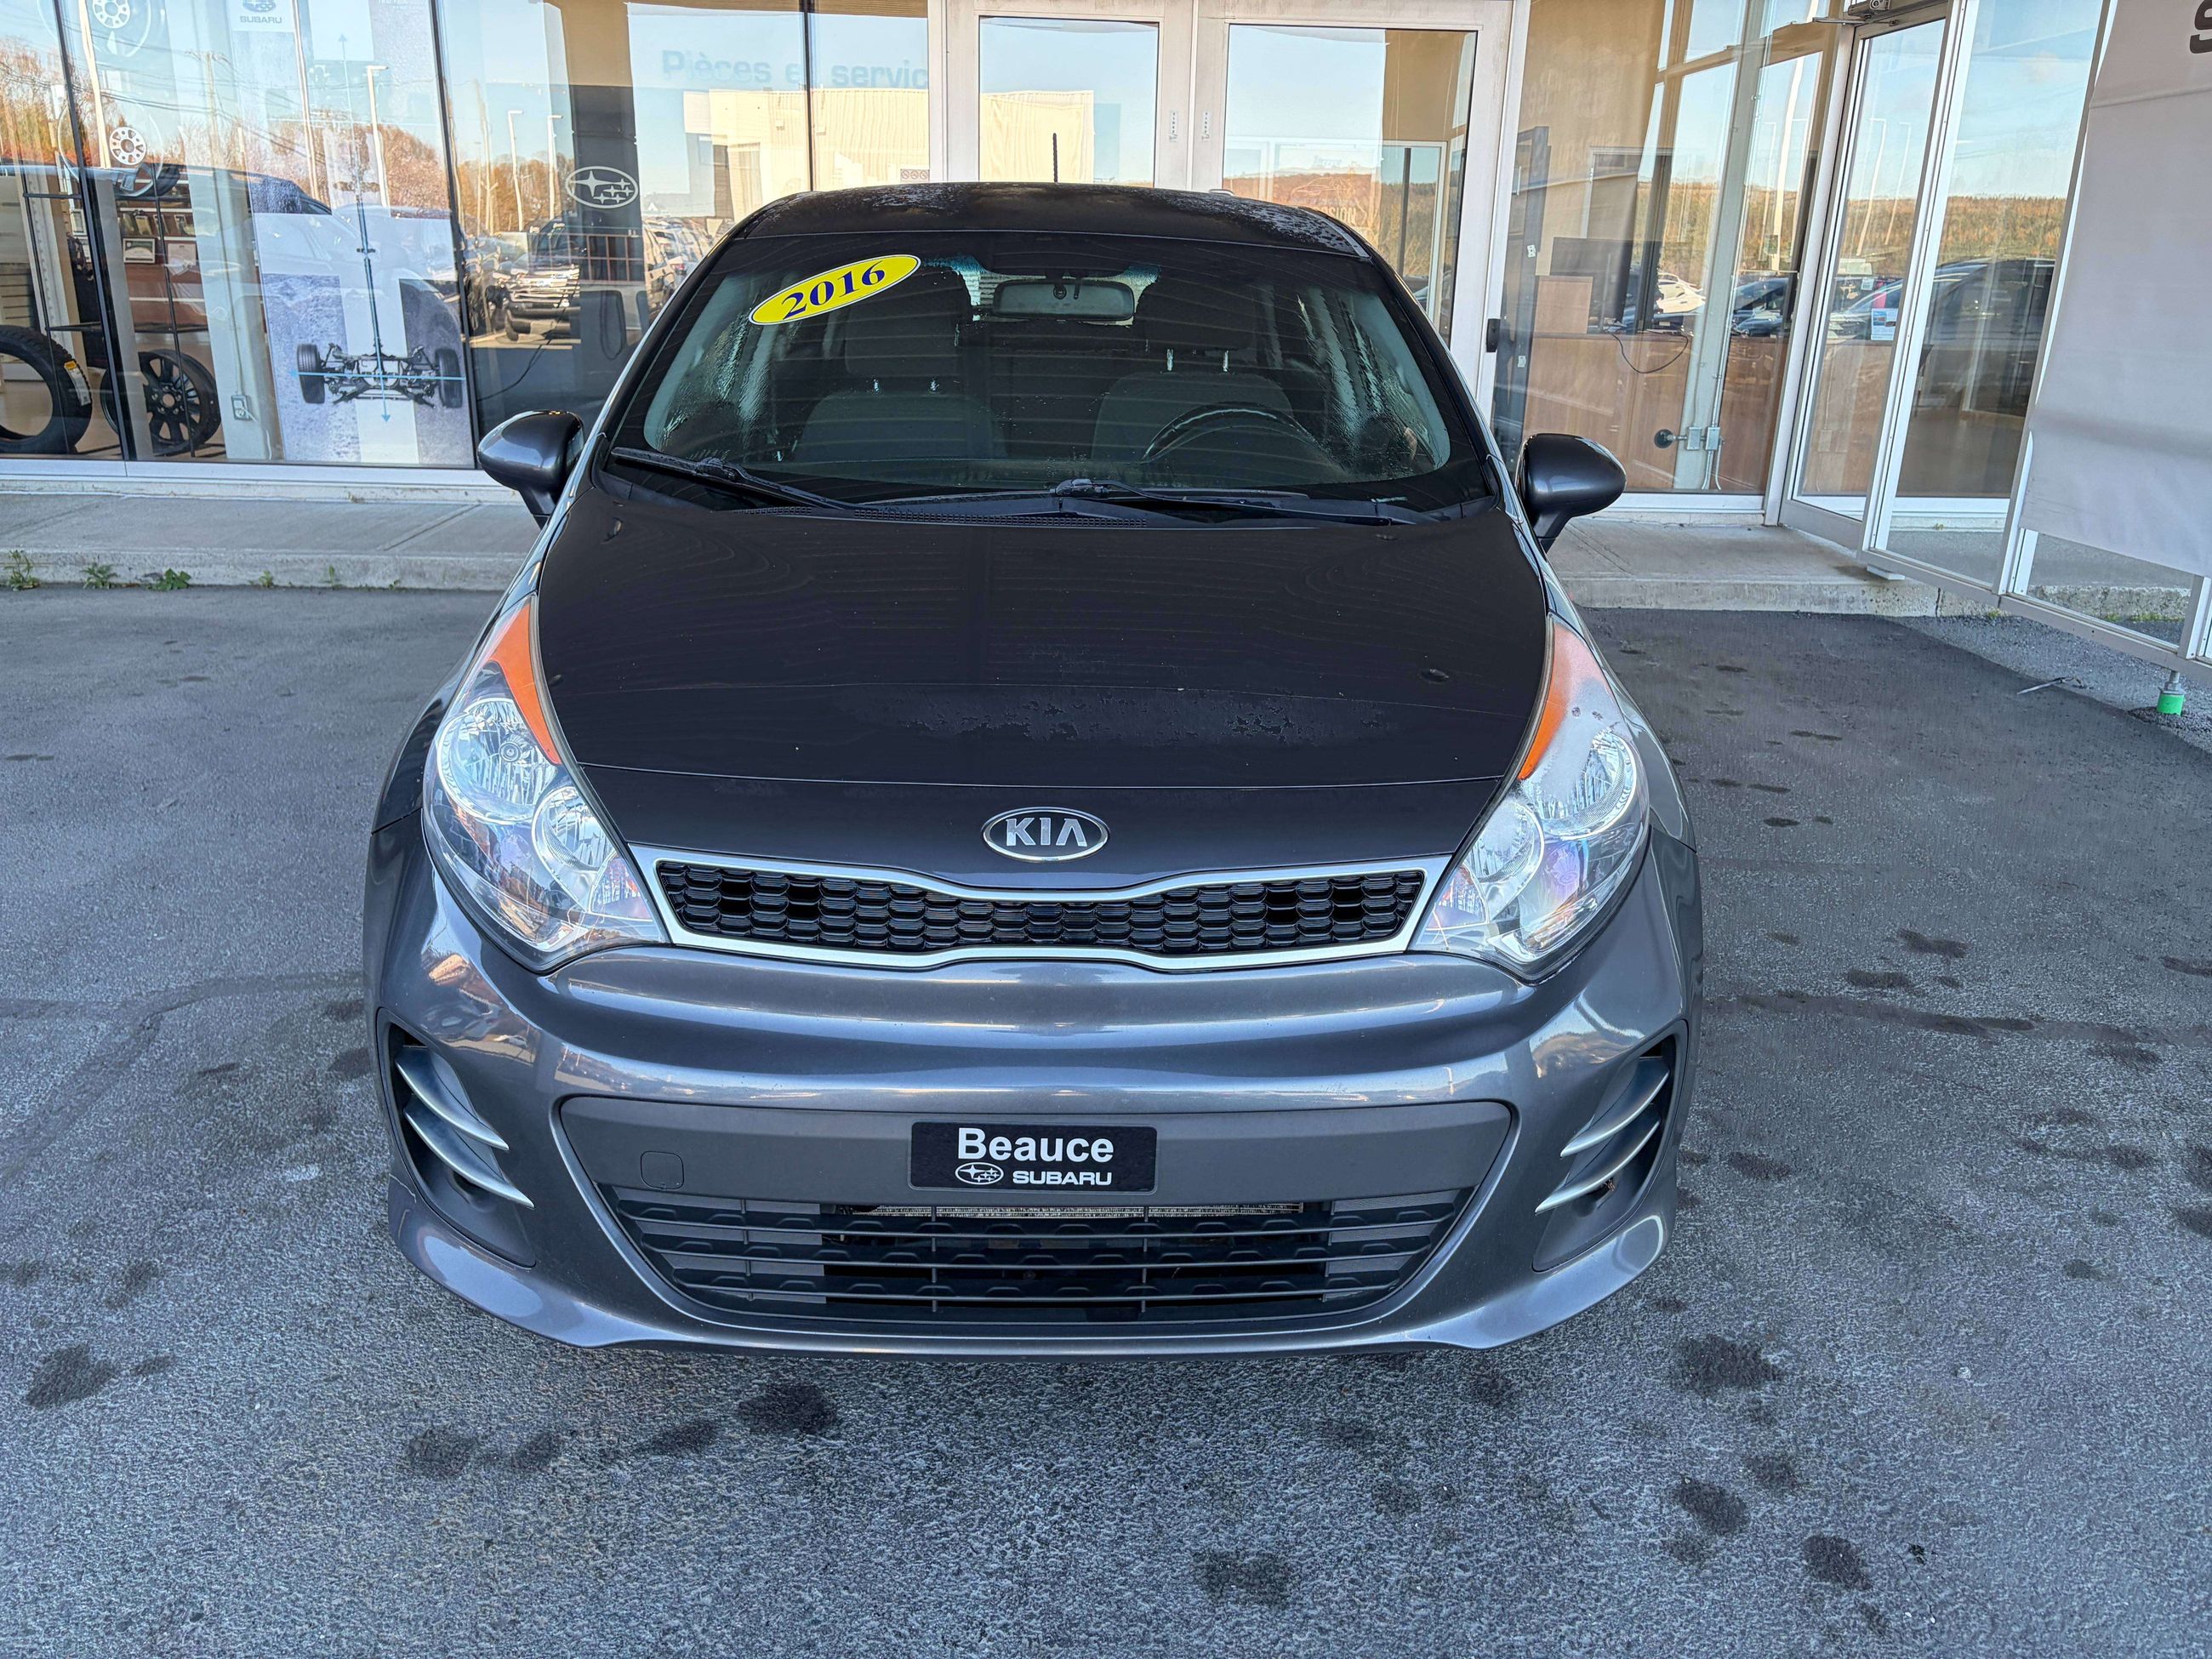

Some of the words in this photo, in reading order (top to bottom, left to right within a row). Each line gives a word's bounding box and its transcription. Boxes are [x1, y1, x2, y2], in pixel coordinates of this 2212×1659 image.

[240, 15, 282, 24] SUBARU
[662, 49, 772, 83] Pièces
[785, 63, 806, 84] e
[831, 60, 929, 89] servic
[781, 260, 886, 320] 2016
[1005, 817, 1088, 847] KIA
[958, 1127, 1115, 1163] Beauce
[1012, 1170, 1112, 1185] SUBARU
